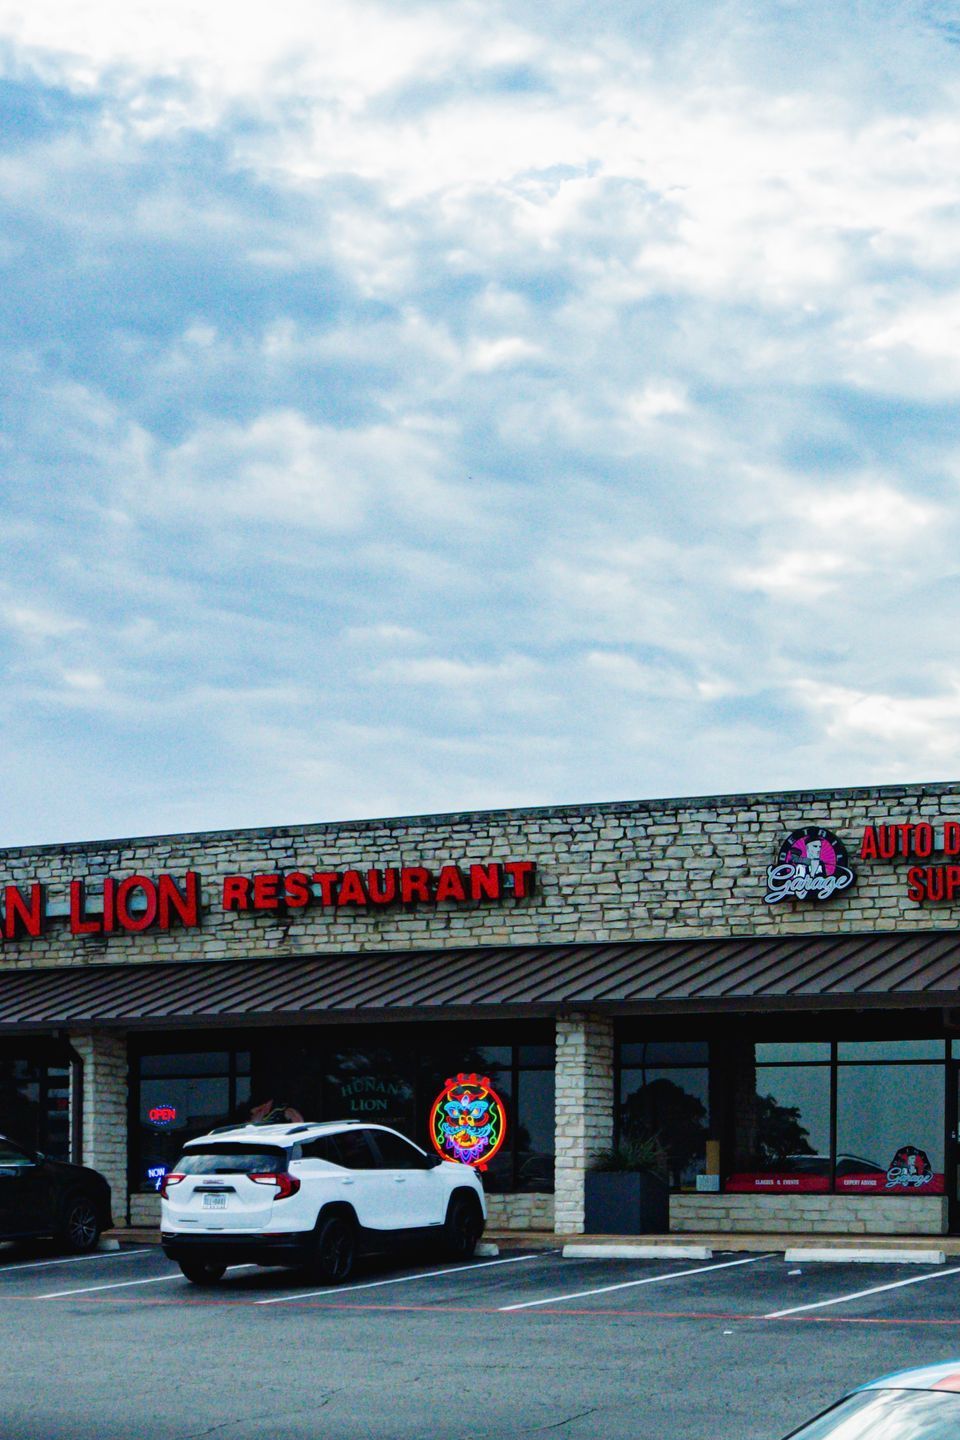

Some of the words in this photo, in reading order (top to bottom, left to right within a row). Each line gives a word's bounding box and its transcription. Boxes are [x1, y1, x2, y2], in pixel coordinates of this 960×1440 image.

[860, 822, 934, 860] AUTO
[764, 863, 853, 904] Garage
[0, 883, 42, 939] N
[70, 871, 203, 935] LION
[222, 862, 537, 911] RESTAURANT
[148, 1108, 176, 1121] OPEN
[351, 1098, 388, 1111] LION
[147, 1167, 166, 1178] NOW
[885, 1160, 934, 1188] Garage
